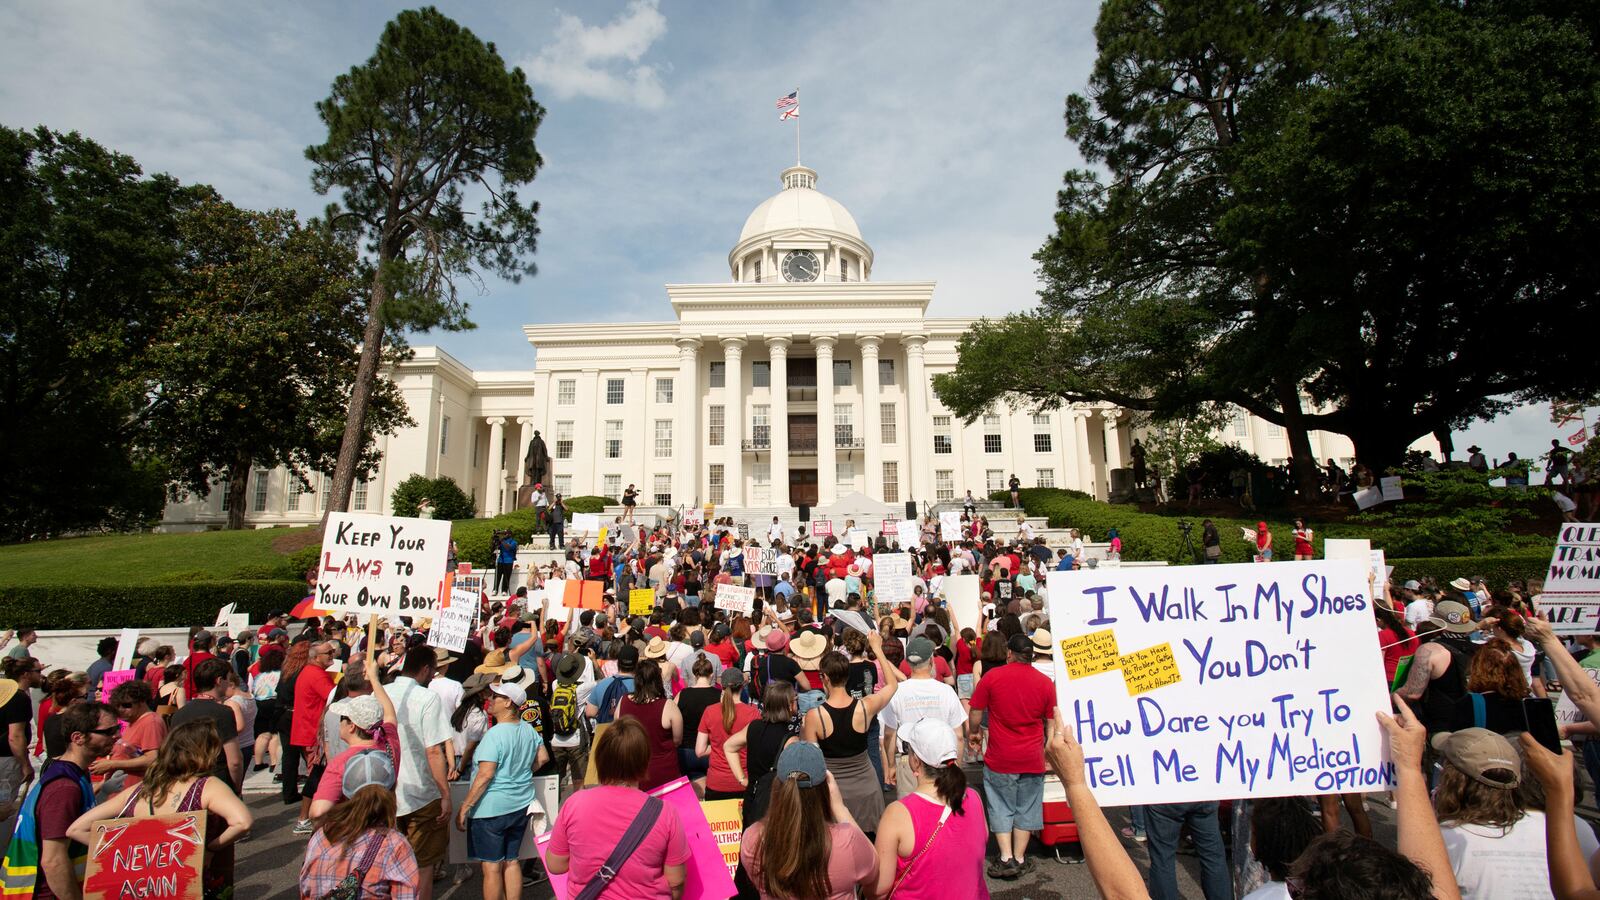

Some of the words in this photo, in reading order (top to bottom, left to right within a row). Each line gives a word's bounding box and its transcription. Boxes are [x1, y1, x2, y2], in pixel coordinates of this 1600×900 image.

[336, 521, 381, 547] KEEP
[390, 524, 426, 551] YOUR
[1562, 526, 1600, 543] QUE
[323, 551, 383, 578] LAWS
[395, 561, 413, 577] TO
[761, 549, 776, 561] BODY
[319, 583, 348, 605] YOUR
[357, 586, 391, 609] OWN
[399, 580, 444, 611] BODY!
[1082, 585, 1118, 626] I
[1128, 584, 1208, 623] Walk
[1215, 583, 1248, 623] In
[1253, 581, 1294, 635] My
[1300, 573, 1367, 619] Shoes
[1061, 640, 1084, 651] Cancer
[1085, 635, 1093, 646] Is
[1093, 633, 1115, 642] Living
[1064, 648, 1092, 658] Growing
[1092, 643, 1112, 652] Cells
[1088, 654, 1102, 662] Your
[1120, 657, 1135, 666] But
[1136, 652, 1148, 660] You
[1150, 646, 1168, 656] Have
[1183, 636, 1241, 685] You
[1245, 637, 1317, 678] Don't
[1070, 668, 1081, 676] By
[1083, 664, 1098, 673] Your
[1123, 667, 1133, 676] No
[1133, 660, 1155, 671] Problem
[1126, 673, 1147, 684] Them
[1134, 683, 1154, 693] Think
[1073, 699, 1131, 745] How
[1137, 697, 1210, 737] Dare
[1218, 711, 1265, 740] you
[1272, 694, 1314, 736] Try
[1318, 688, 1351, 724] To
[1084, 754, 1136, 788] Tell
[1152, 749, 1199, 785] Me
[1215, 740, 1260, 792] My
[1267, 732, 1361, 782] Medical
[710, 820, 740, 831] ORTION
[113, 840, 184, 873] NEVER
[119, 872, 177, 900] AGAIN
